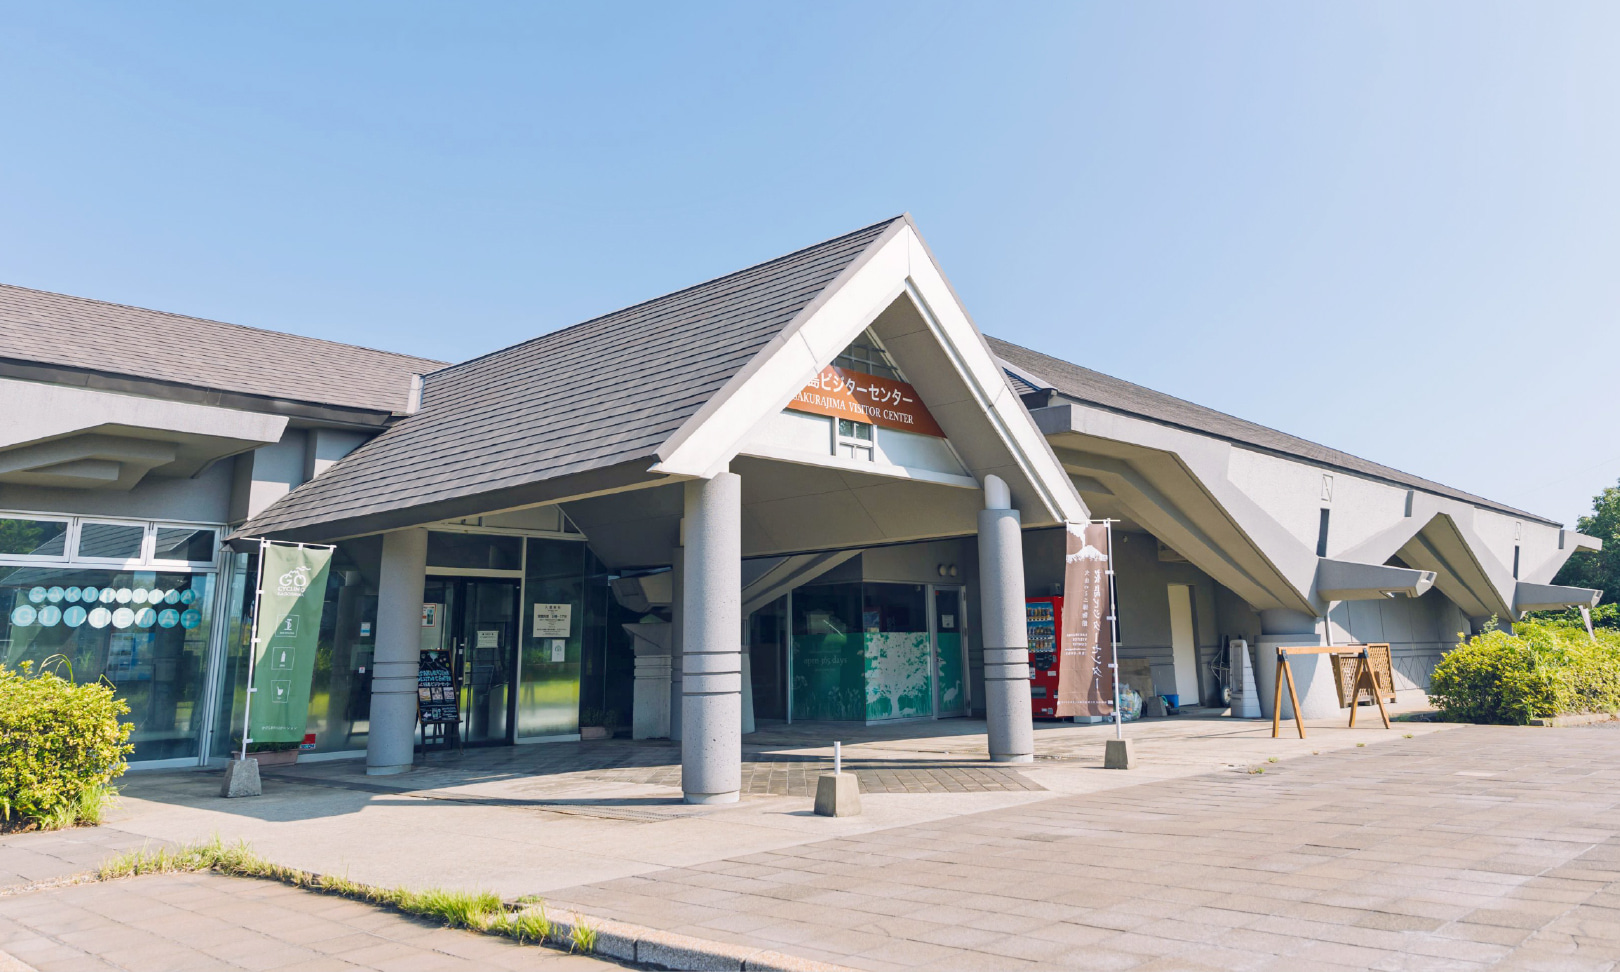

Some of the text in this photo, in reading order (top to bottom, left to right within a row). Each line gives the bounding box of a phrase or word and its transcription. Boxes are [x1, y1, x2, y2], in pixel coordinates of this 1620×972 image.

[849, 402, 881, 418] VISITOR
[883, 409, 914, 425] CENTER
[279, 573, 307, 587] GO
[31, 587, 194, 604] SAKURAJIMA
